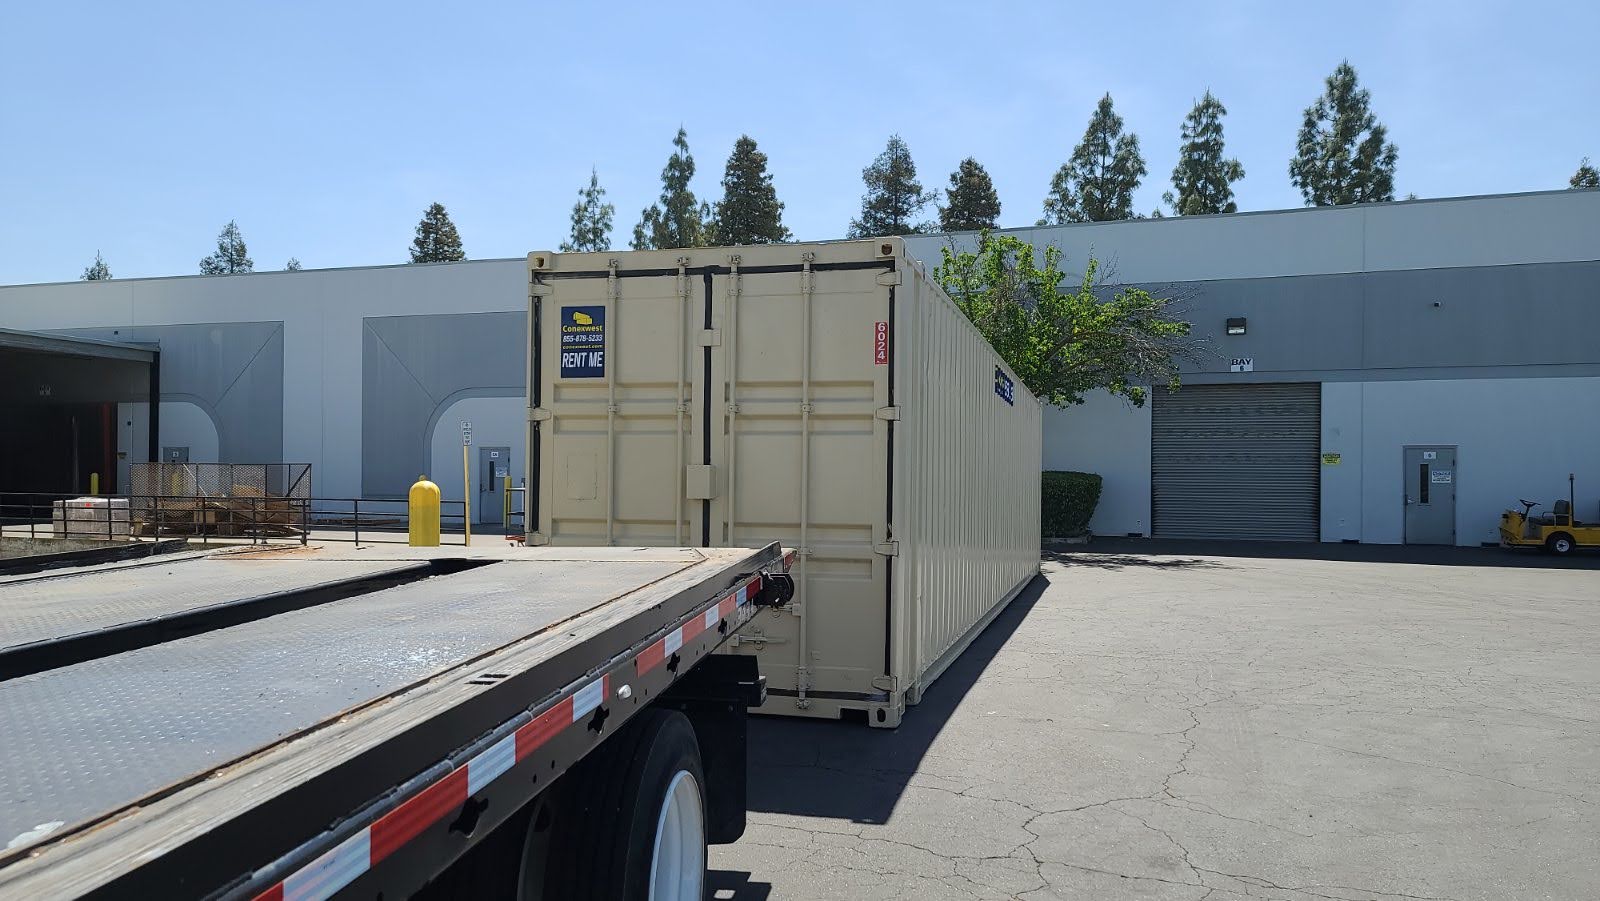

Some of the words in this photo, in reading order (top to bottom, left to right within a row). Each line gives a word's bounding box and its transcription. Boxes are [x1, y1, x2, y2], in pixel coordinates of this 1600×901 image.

[878, 322, 886, 360] 6024
[562, 352, 587, 368] RENT
[588, 351, 604, 367] ME
